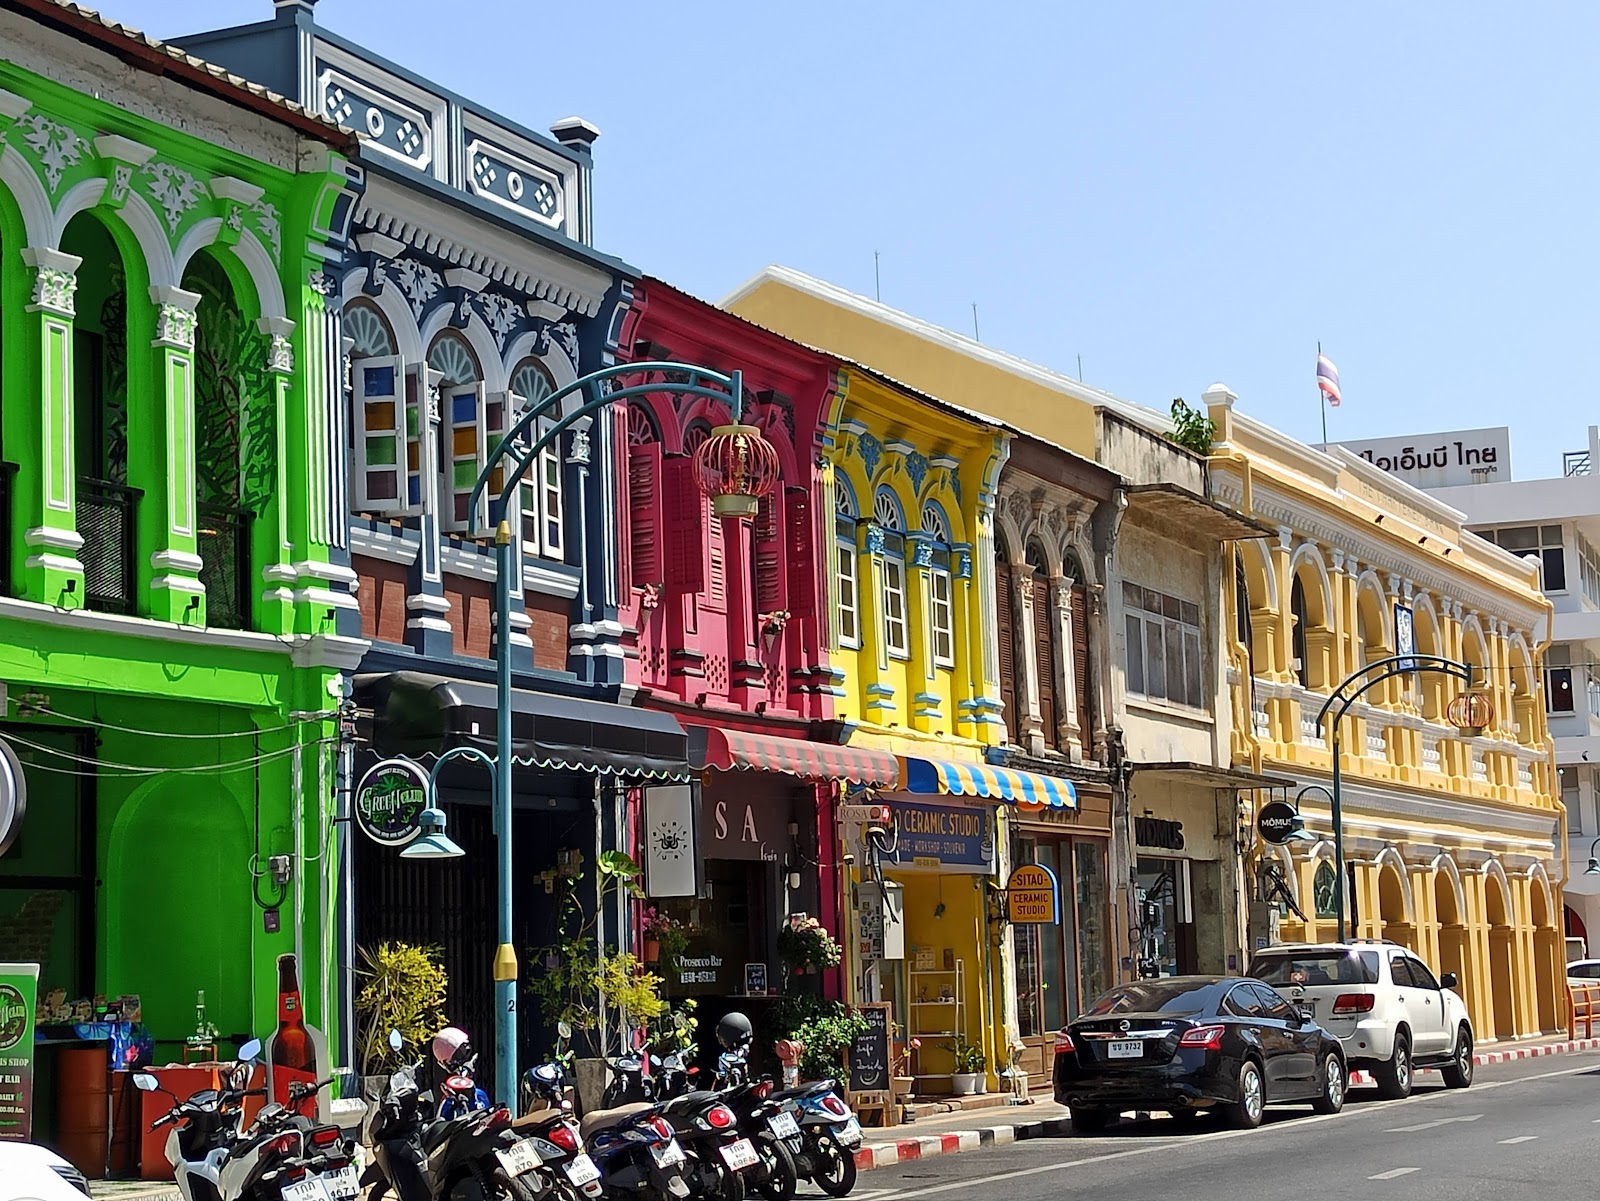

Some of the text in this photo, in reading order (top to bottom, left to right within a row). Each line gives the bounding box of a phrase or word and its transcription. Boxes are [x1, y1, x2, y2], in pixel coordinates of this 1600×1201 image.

[1453, 442, 1497, 465] ไทย
[840, 809, 868, 819] ROSA
[904, 809, 946, 835] CERAMIC
[949, 813, 980, 837] STUDIO
[1013, 893, 1049, 904] CERAMIC
[1017, 905, 1046, 915] STUDIO
[680, 955, 723, 967] Prosecco Bar
[508, 999, 515, 1012] 2
[8, 1058, 30, 1067] SHOP
[4, 1075, 21, 1084] BAR
[330, 1185, 356, 1198] 4671
